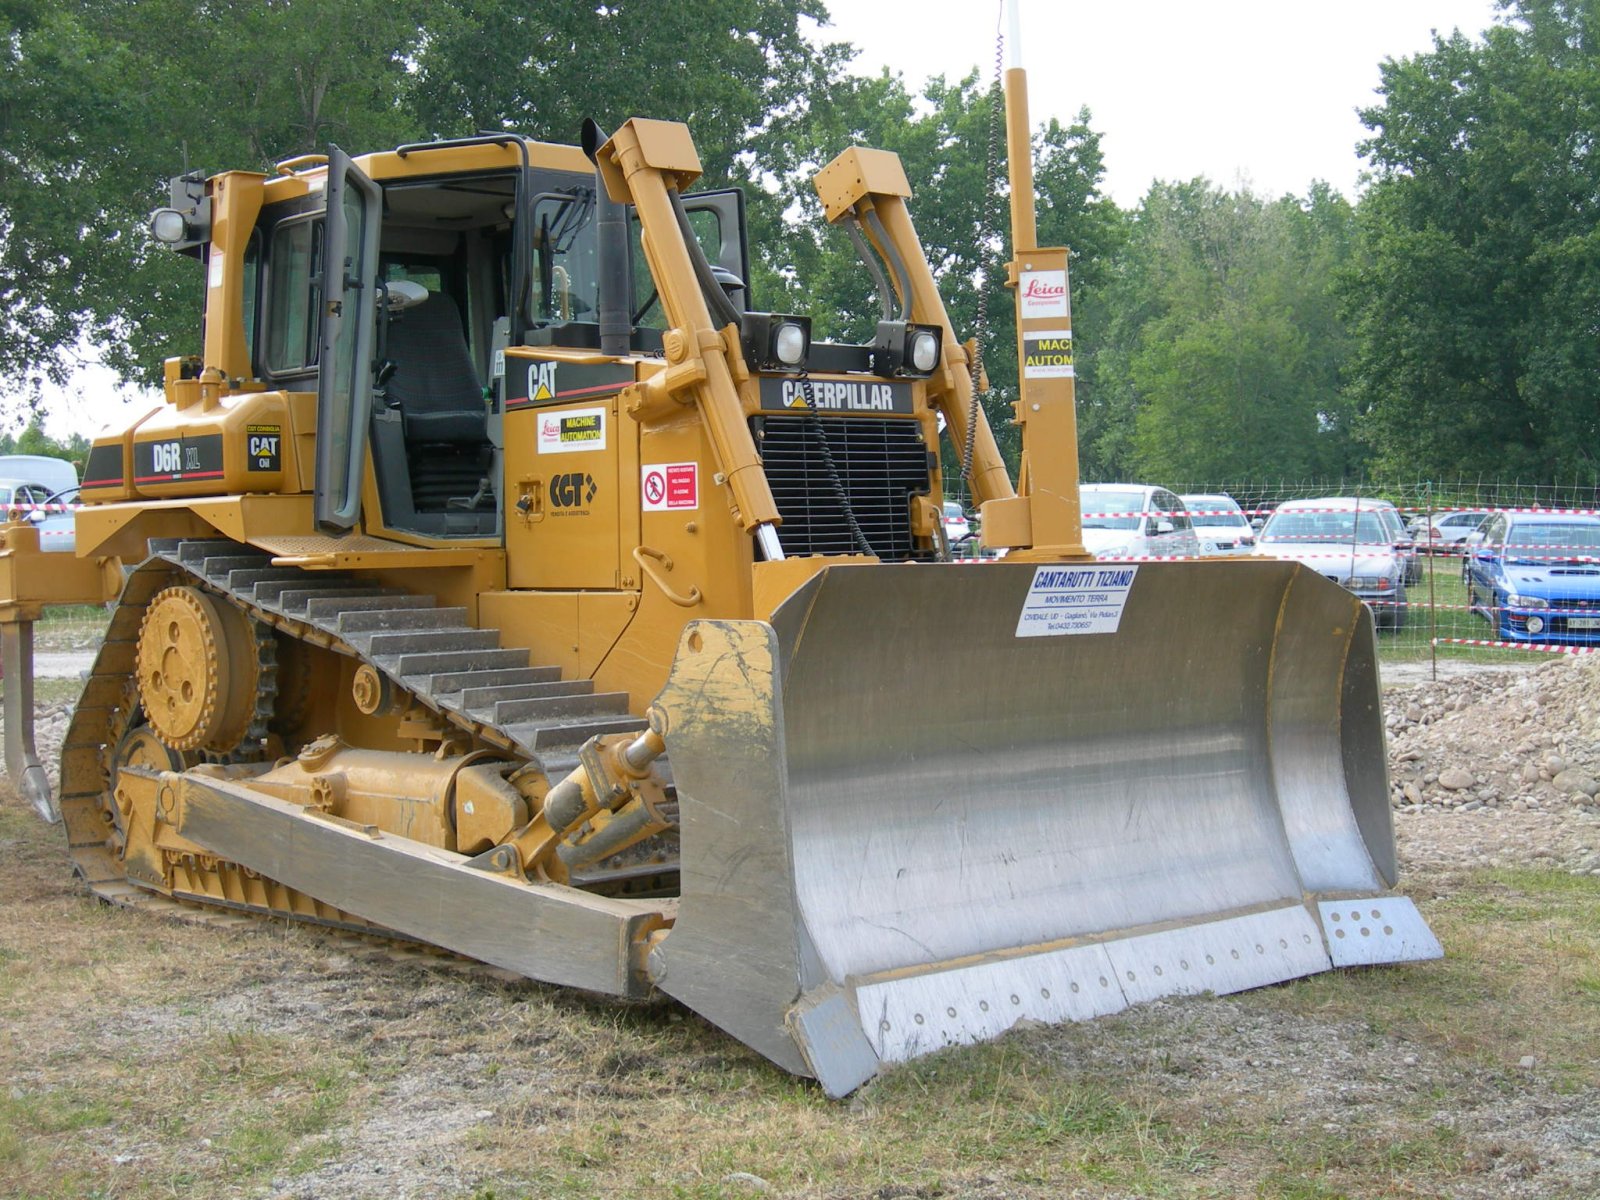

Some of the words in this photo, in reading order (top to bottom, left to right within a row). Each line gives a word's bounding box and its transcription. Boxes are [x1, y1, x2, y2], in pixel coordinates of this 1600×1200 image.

[1022, 279, 1065, 298] Leica
[528, 361, 558, 401] CAT
[782, 380, 893, 410] CATERPILLAR
[543, 419, 560, 436] Leica
[566, 416, 596, 428] MACHINE
[560, 430, 602, 442] AUTOMATION
[250, 436, 279, 456] CAT
[153, 442, 181, 473] D6R
[185, 447, 200, 470] XL
[259, 458, 270, 468] Oil
[549, 473, 584, 507] CGT
[1034, 571, 1096, 589] CANTARUTTI
[1096, 570, 1133, 587] TIZIANO
[1045, 594, 1085, 603] MOVIMENTO
[1087, 594, 1108, 603] TERRA
